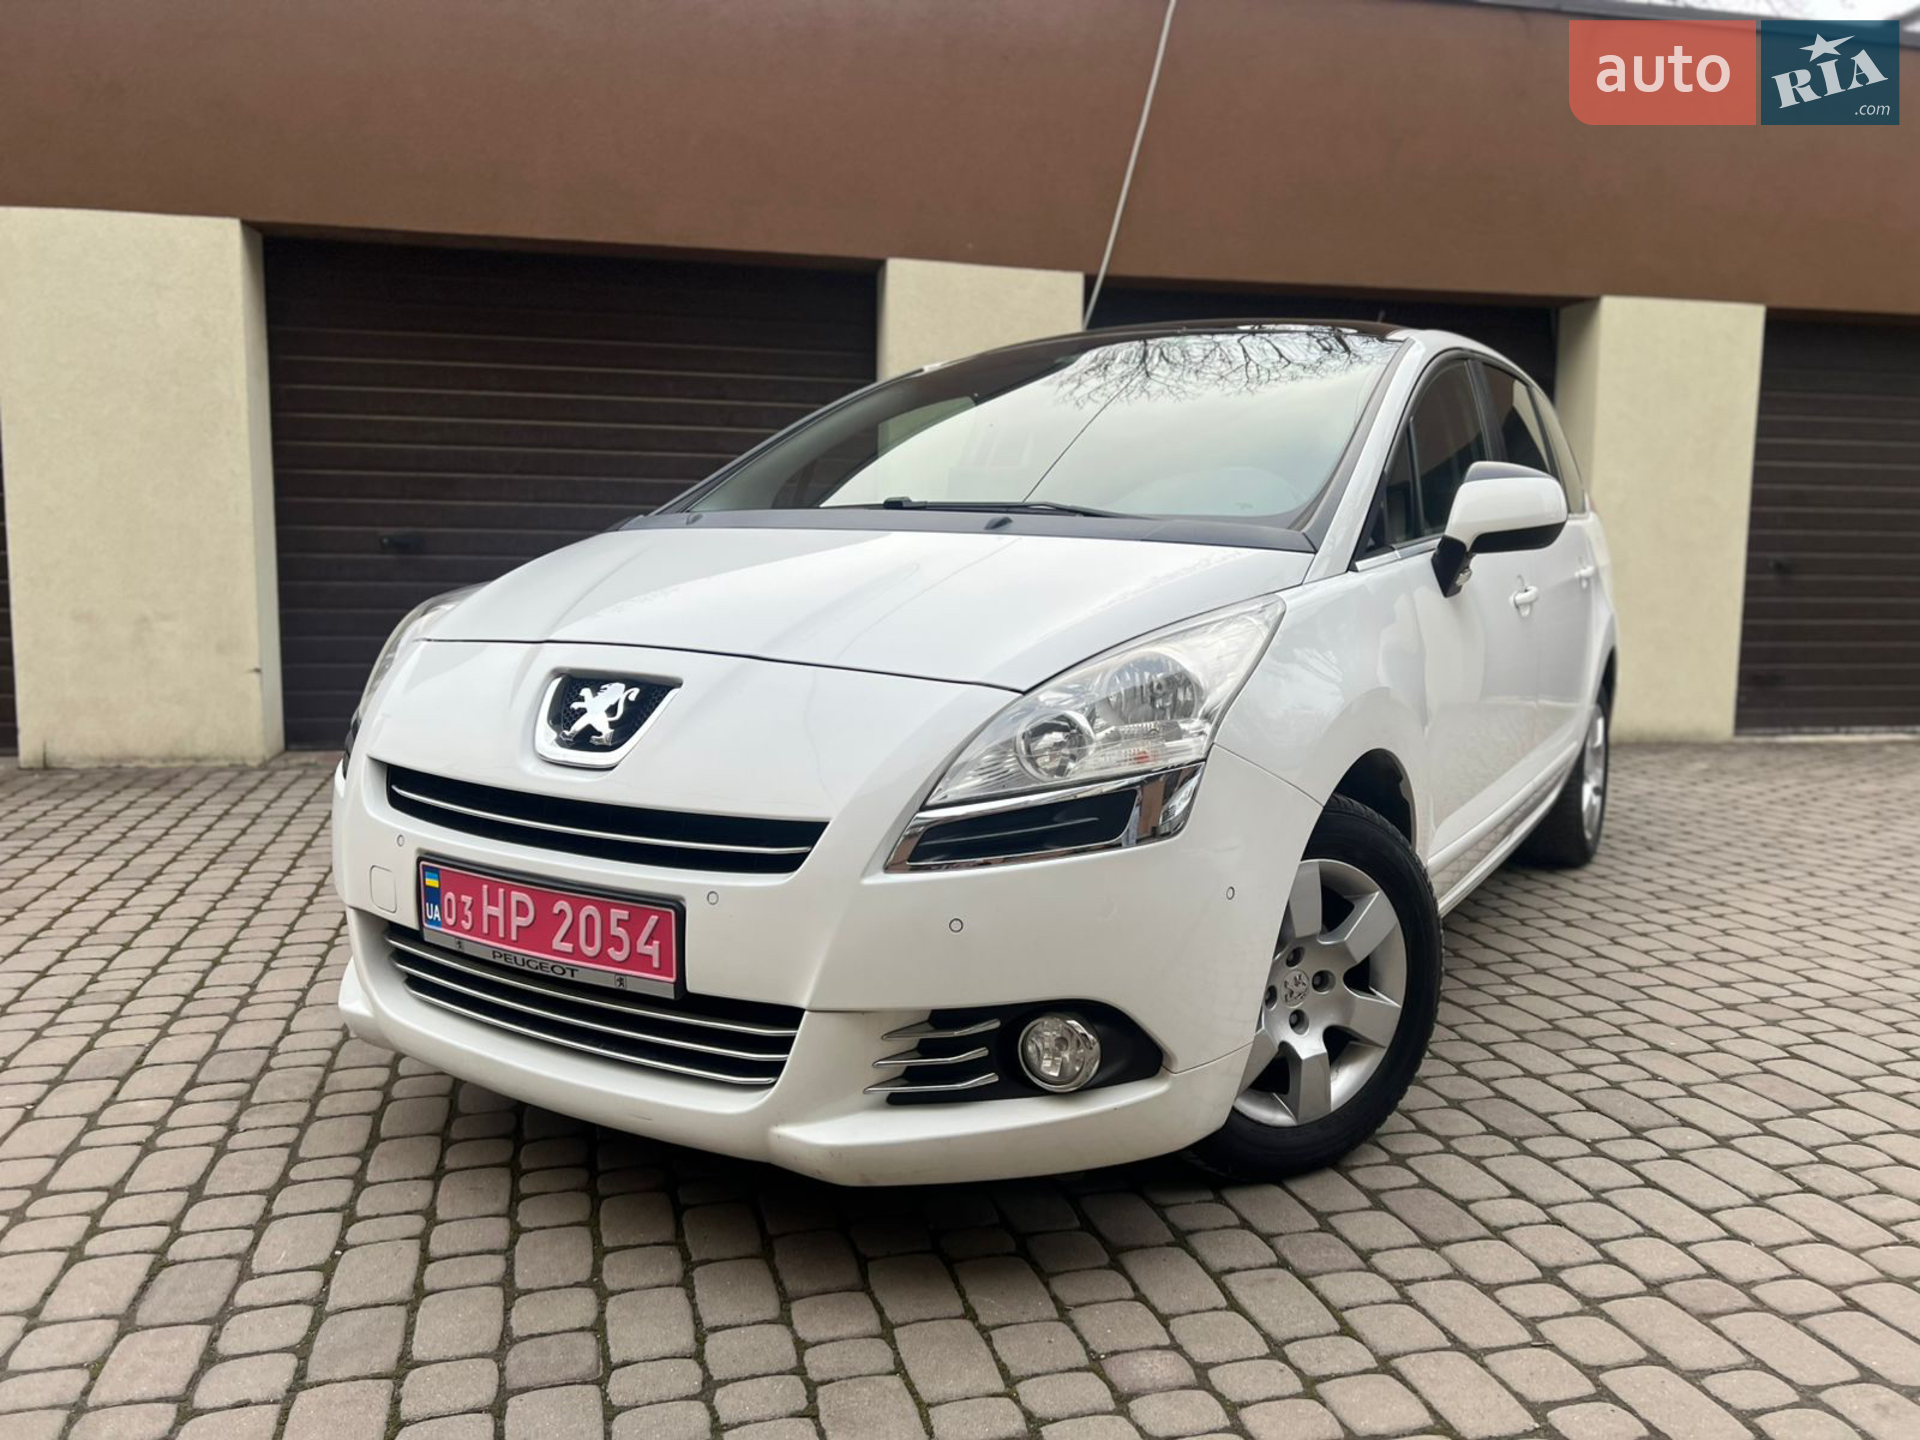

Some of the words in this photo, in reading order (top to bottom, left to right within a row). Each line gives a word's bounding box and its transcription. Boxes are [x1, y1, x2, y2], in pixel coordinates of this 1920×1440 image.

[425, 903, 441, 921] UA
[443, 891, 473, 931] 03
[482, 884, 536, 942] HP
[551, 900, 661, 969] 2054
[491, 950, 580, 979] PEUGEOT
